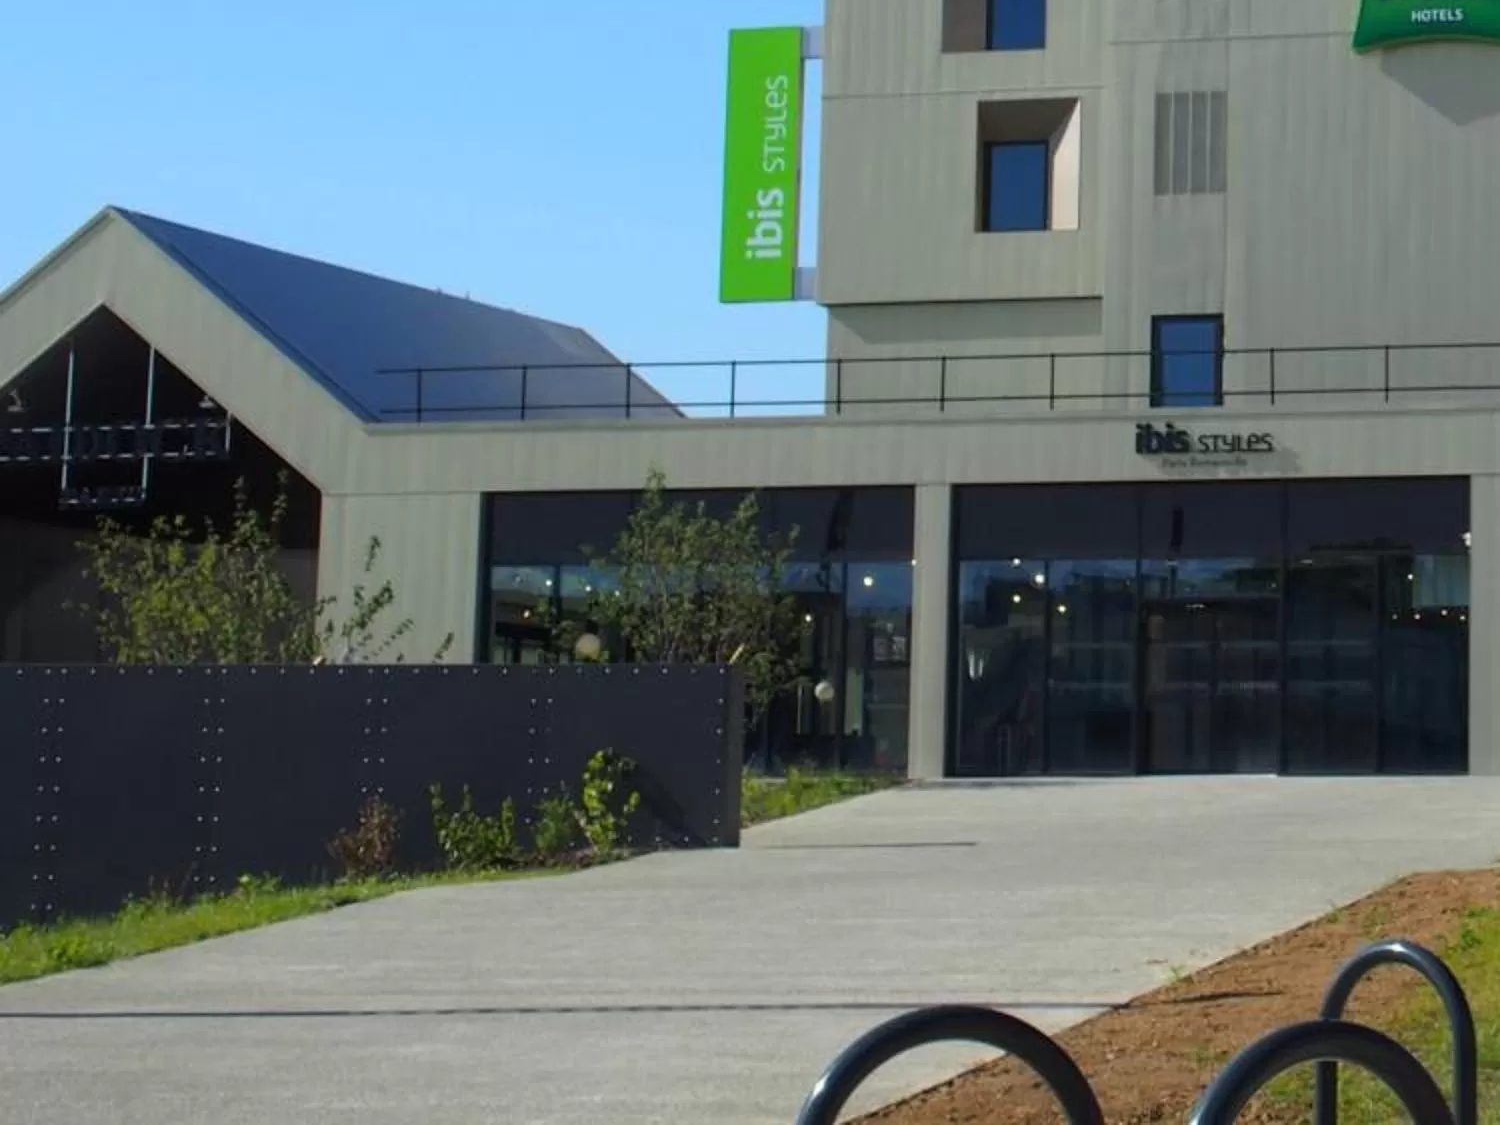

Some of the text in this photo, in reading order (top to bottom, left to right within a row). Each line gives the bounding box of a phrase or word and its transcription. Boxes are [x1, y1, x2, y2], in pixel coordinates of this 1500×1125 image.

[1411, 8, 1464, 23] HOTELS
[746, 187, 784, 259] ibis
[1135, 422, 1190, 455] ibis
